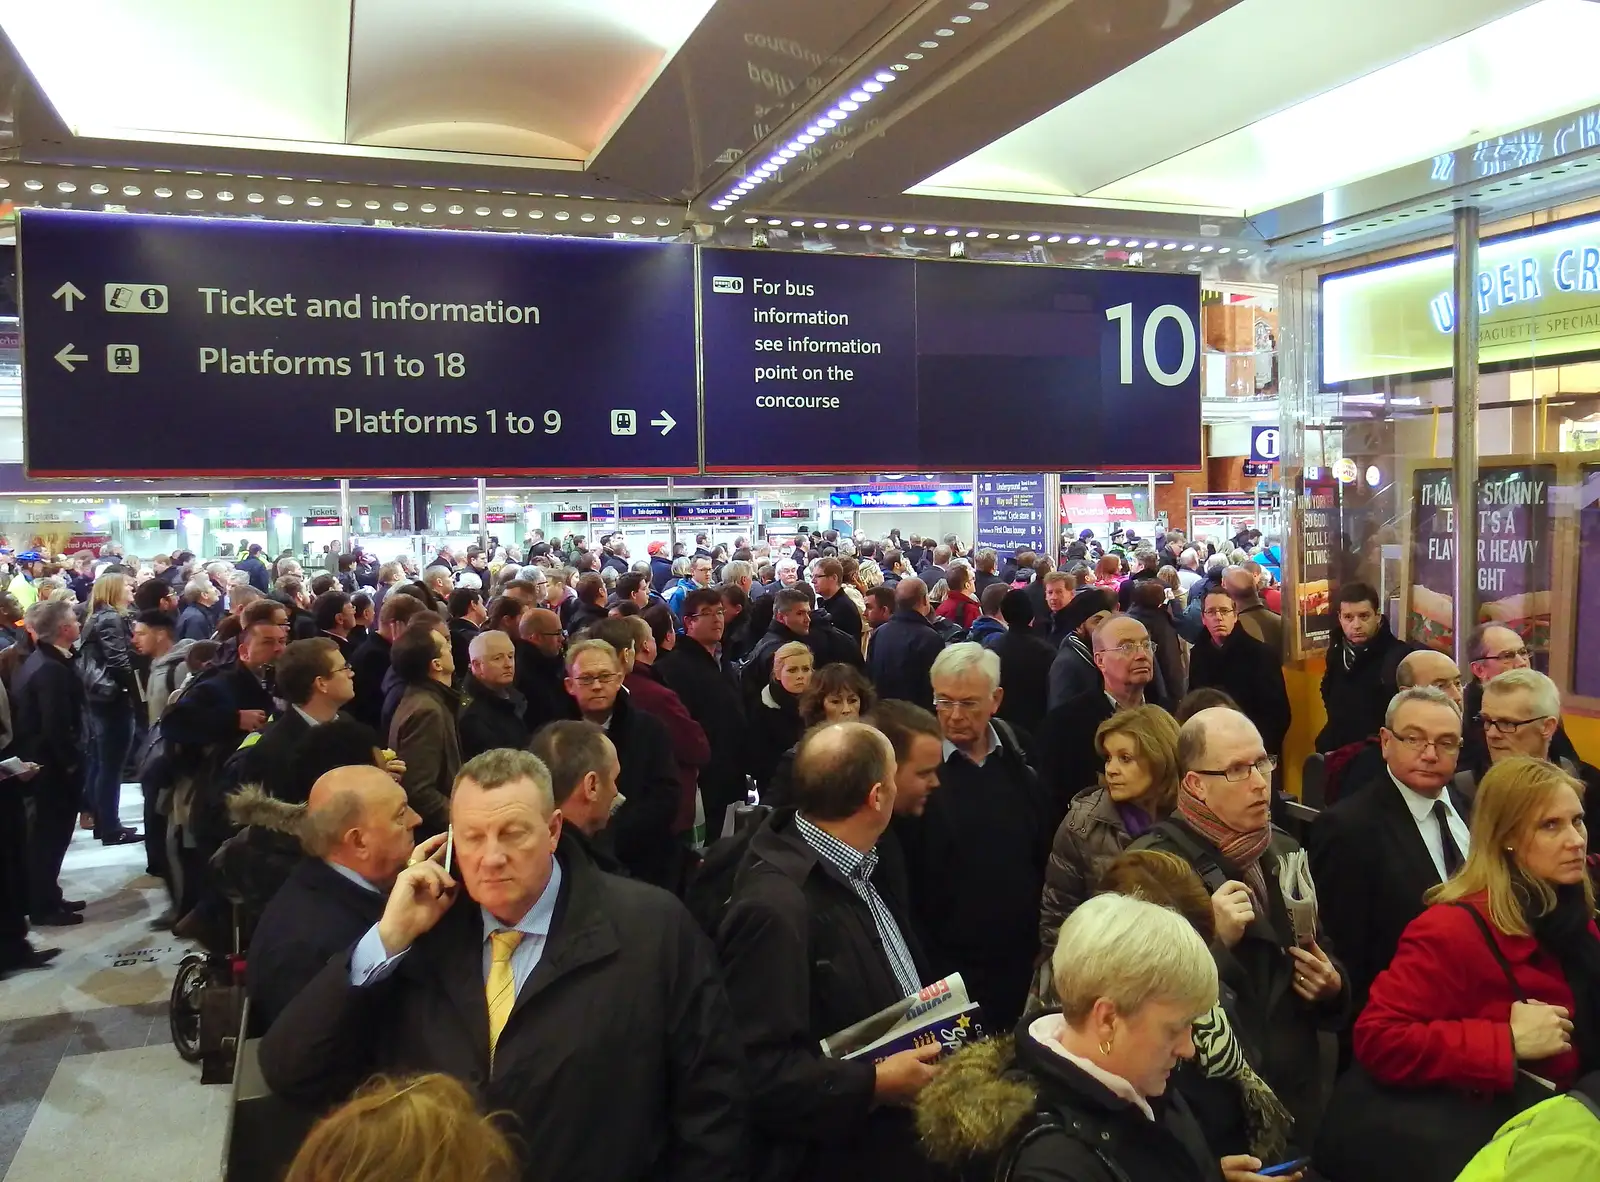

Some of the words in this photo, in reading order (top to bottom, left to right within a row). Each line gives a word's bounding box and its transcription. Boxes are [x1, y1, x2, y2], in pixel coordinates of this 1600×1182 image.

[753, 278, 781, 295] For
[785, 279, 815, 297] bus
[1430, 257, 1542, 334] UPER
[198, 287, 297, 317] Ticket
[306, 293, 361, 319] and
[371, 294, 541, 325] information
[753, 306, 849, 326] information
[753, 338, 784, 352] see
[787, 337, 881, 356] information
[1105, 301, 1197, 387] 10
[199, 346, 352, 376] Platforms
[360, 350, 385, 376] 11
[393, 353, 425, 377] to
[433, 352, 466, 378] 18
[754, 364, 798, 384] point
[802, 368, 823, 382] on
[826, 366, 854, 382] the
[755, 394, 840, 410] concourse
[334, 406, 478, 434] Platforms
[485, 409, 497, 433] 1
[505, 411, 535, 434] to
[543, 409, 562, 434] 9
[1483, 480, 1545, 506] SKINNY.
[308, 508, 339, 517] Tickets
[696, 507, 709, 515] Train
[709, 507, 736, 517] departures
[1504, 510, 1517, 534] A
[1490, 539, 1539, 564] HEAVY
